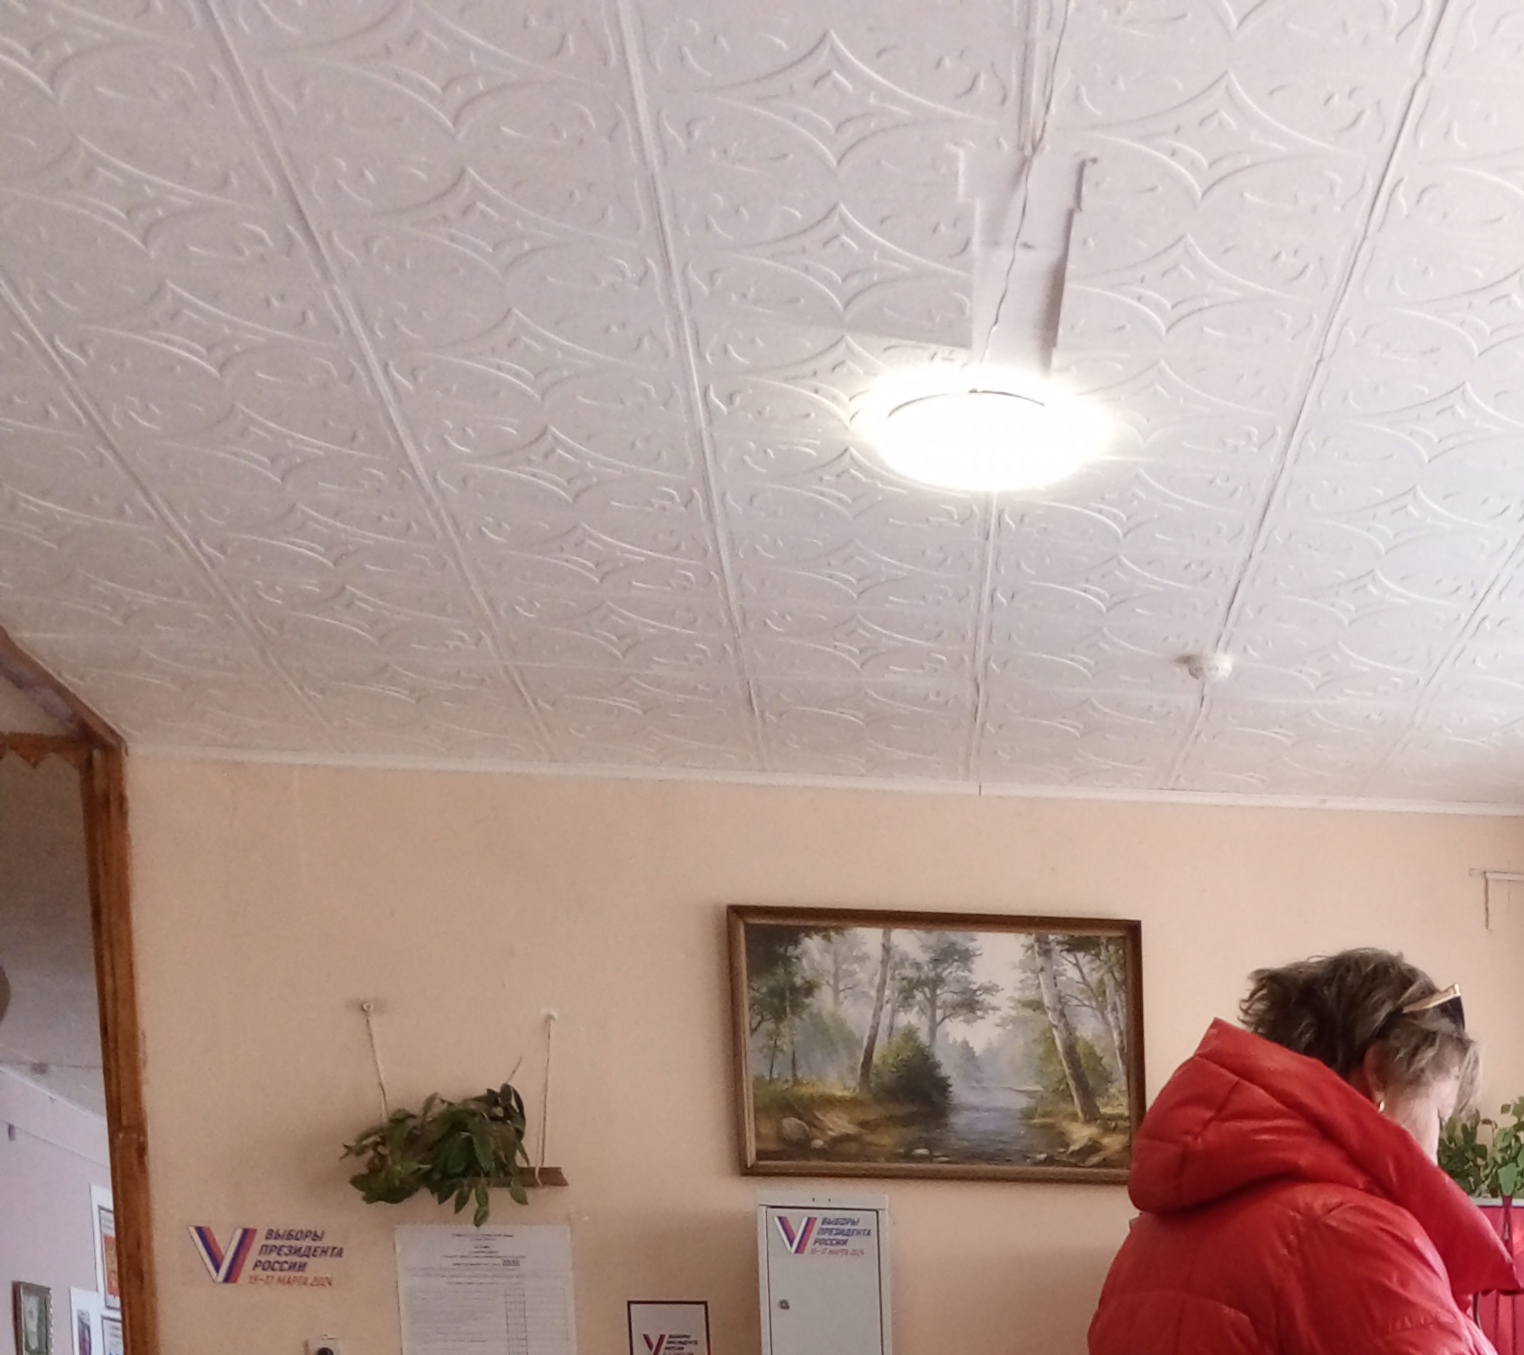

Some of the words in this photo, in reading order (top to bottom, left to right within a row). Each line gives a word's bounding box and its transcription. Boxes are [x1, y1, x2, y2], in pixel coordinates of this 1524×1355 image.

[265, 1228, 325, 1242] ВЫБОРЫ
[258, 1243, 344, 1258] ПРЕЗИДЕНТА
[252, 1259, 308, 1273] РОССИИ
